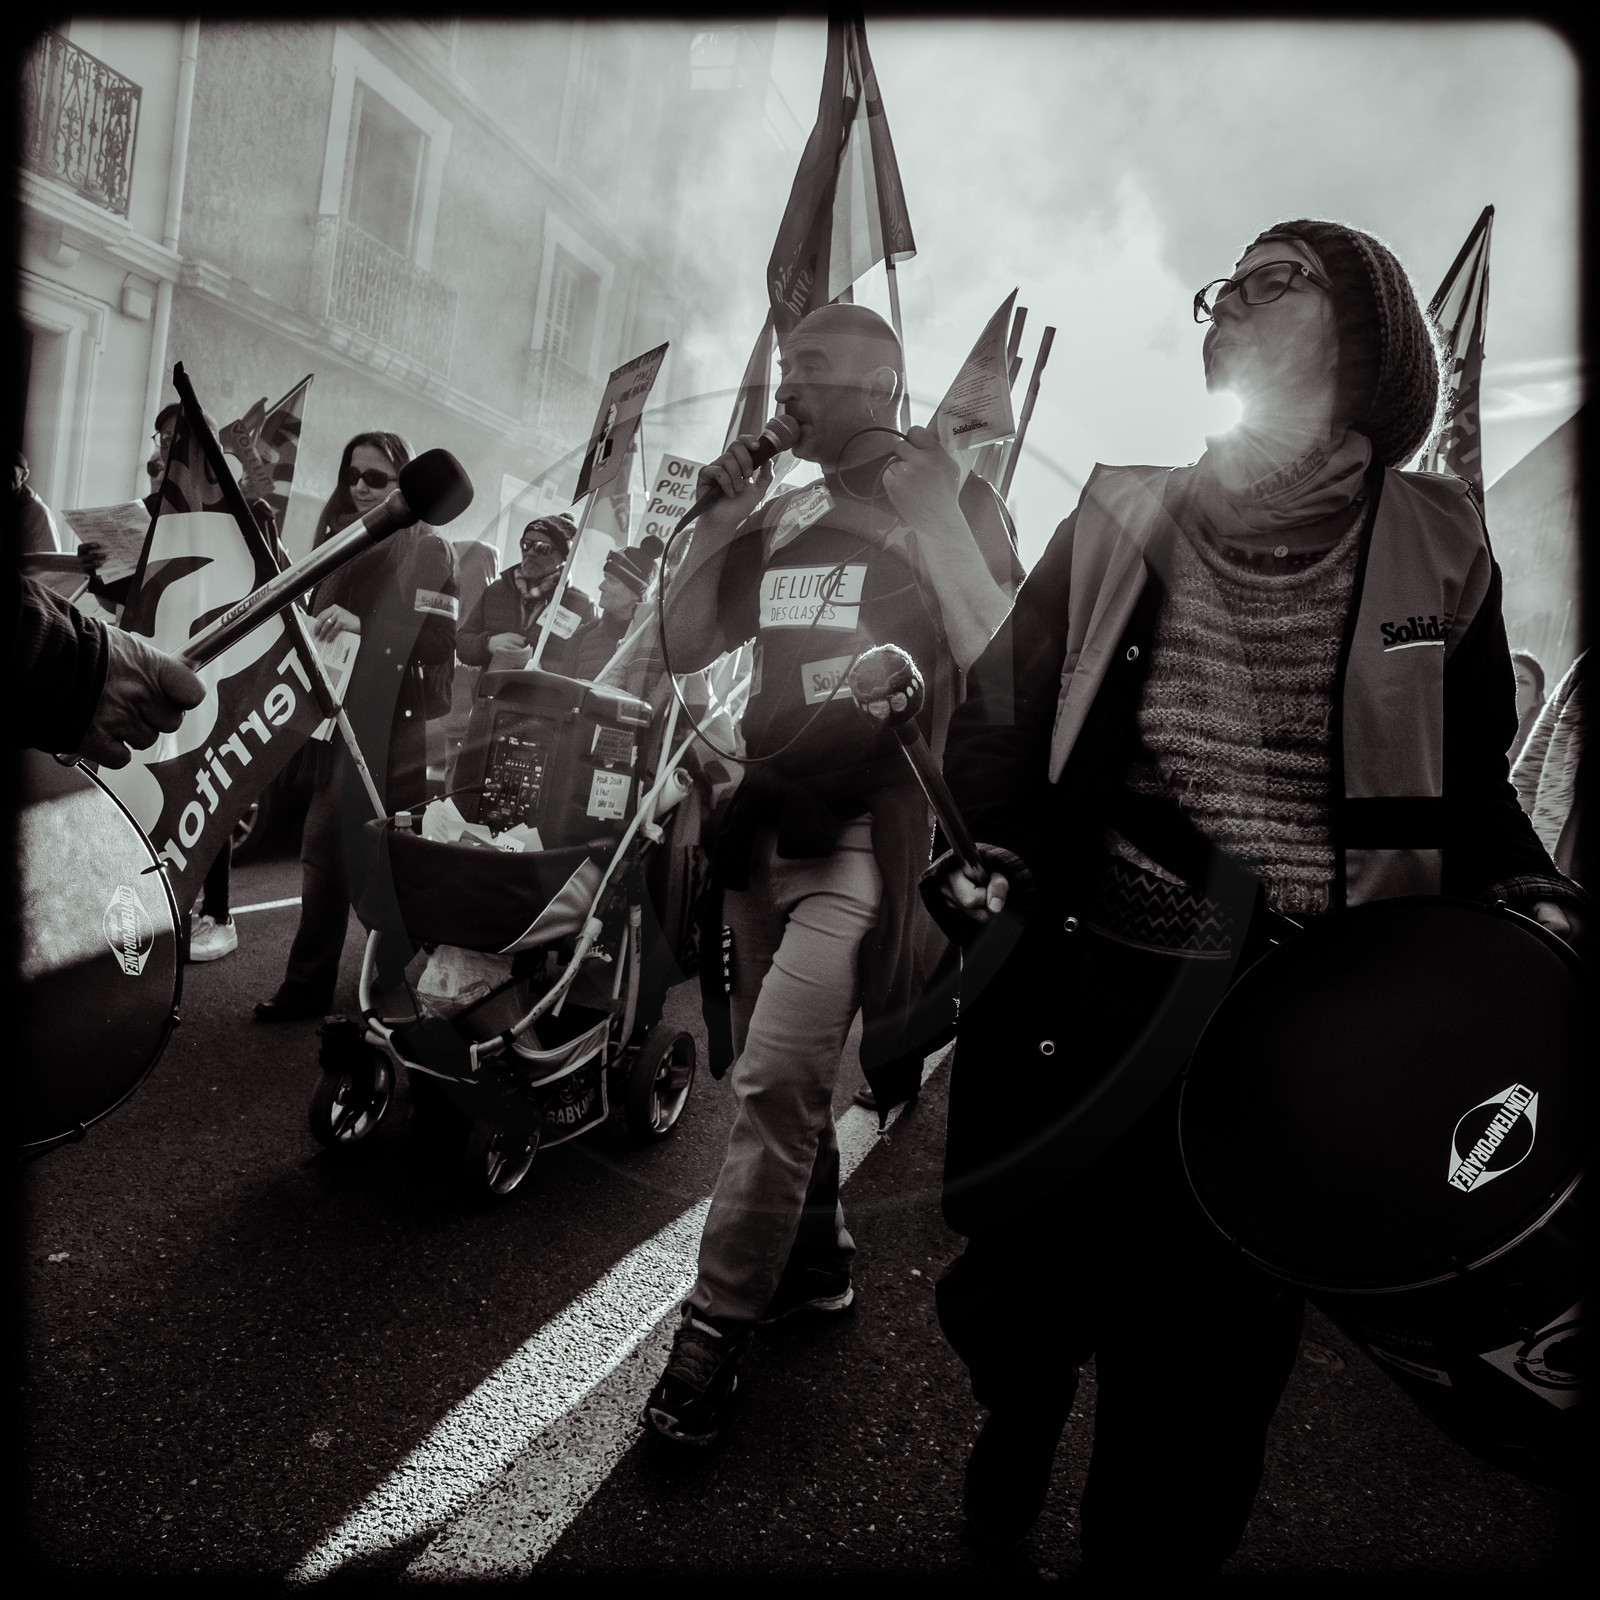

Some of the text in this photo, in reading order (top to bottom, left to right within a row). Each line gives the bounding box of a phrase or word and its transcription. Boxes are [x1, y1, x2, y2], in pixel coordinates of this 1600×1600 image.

[667, 461, 695, 479] ON
[647, 498, 686, 518] POUR
[769, 573, 849, 601] JE LUTTE
[770, 604, 836, 622] DES CLASSES
[812, 669, 849, 692] Soli
